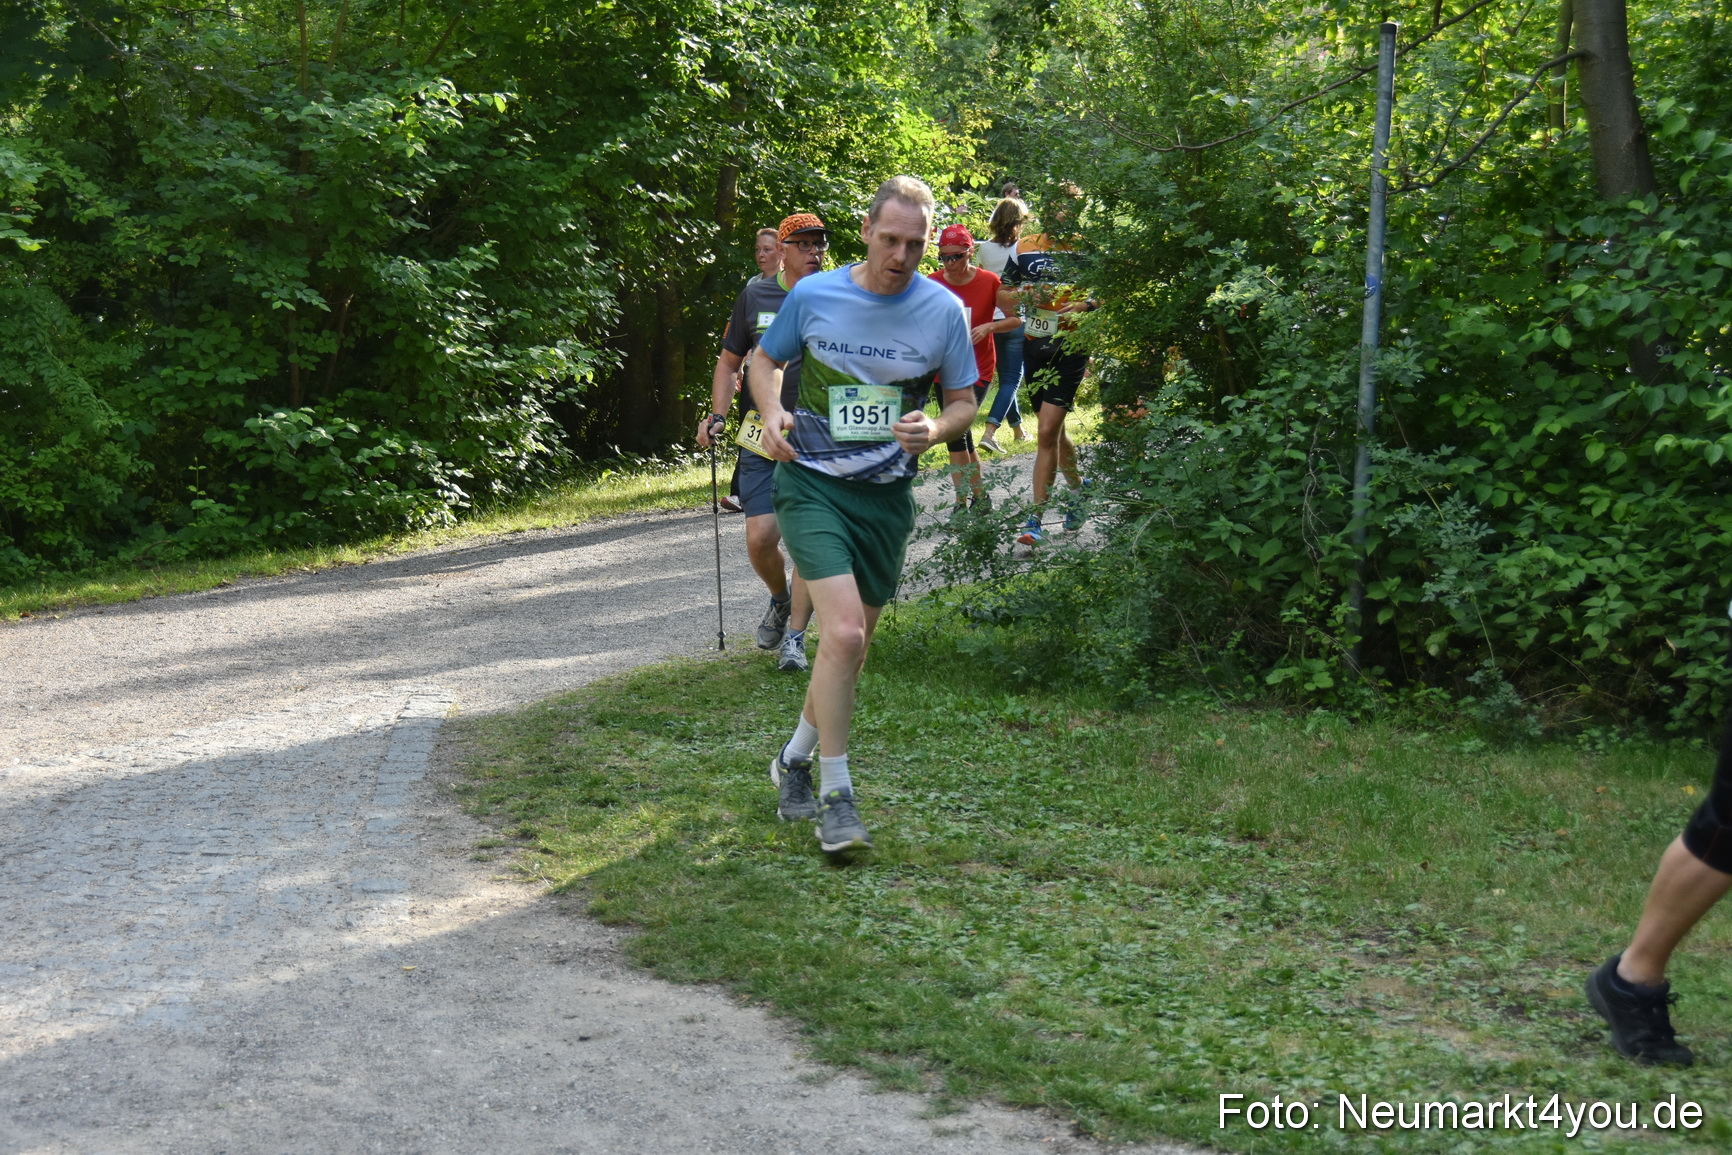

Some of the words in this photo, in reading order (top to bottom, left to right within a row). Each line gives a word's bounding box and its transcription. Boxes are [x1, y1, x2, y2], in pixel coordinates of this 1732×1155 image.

[1036, 261, 1061, 273] Fisc
[1030, 316, 1049, 331] 790
[839, 405, 890, 425] 1951
[747, 424, 763, 442] 31
